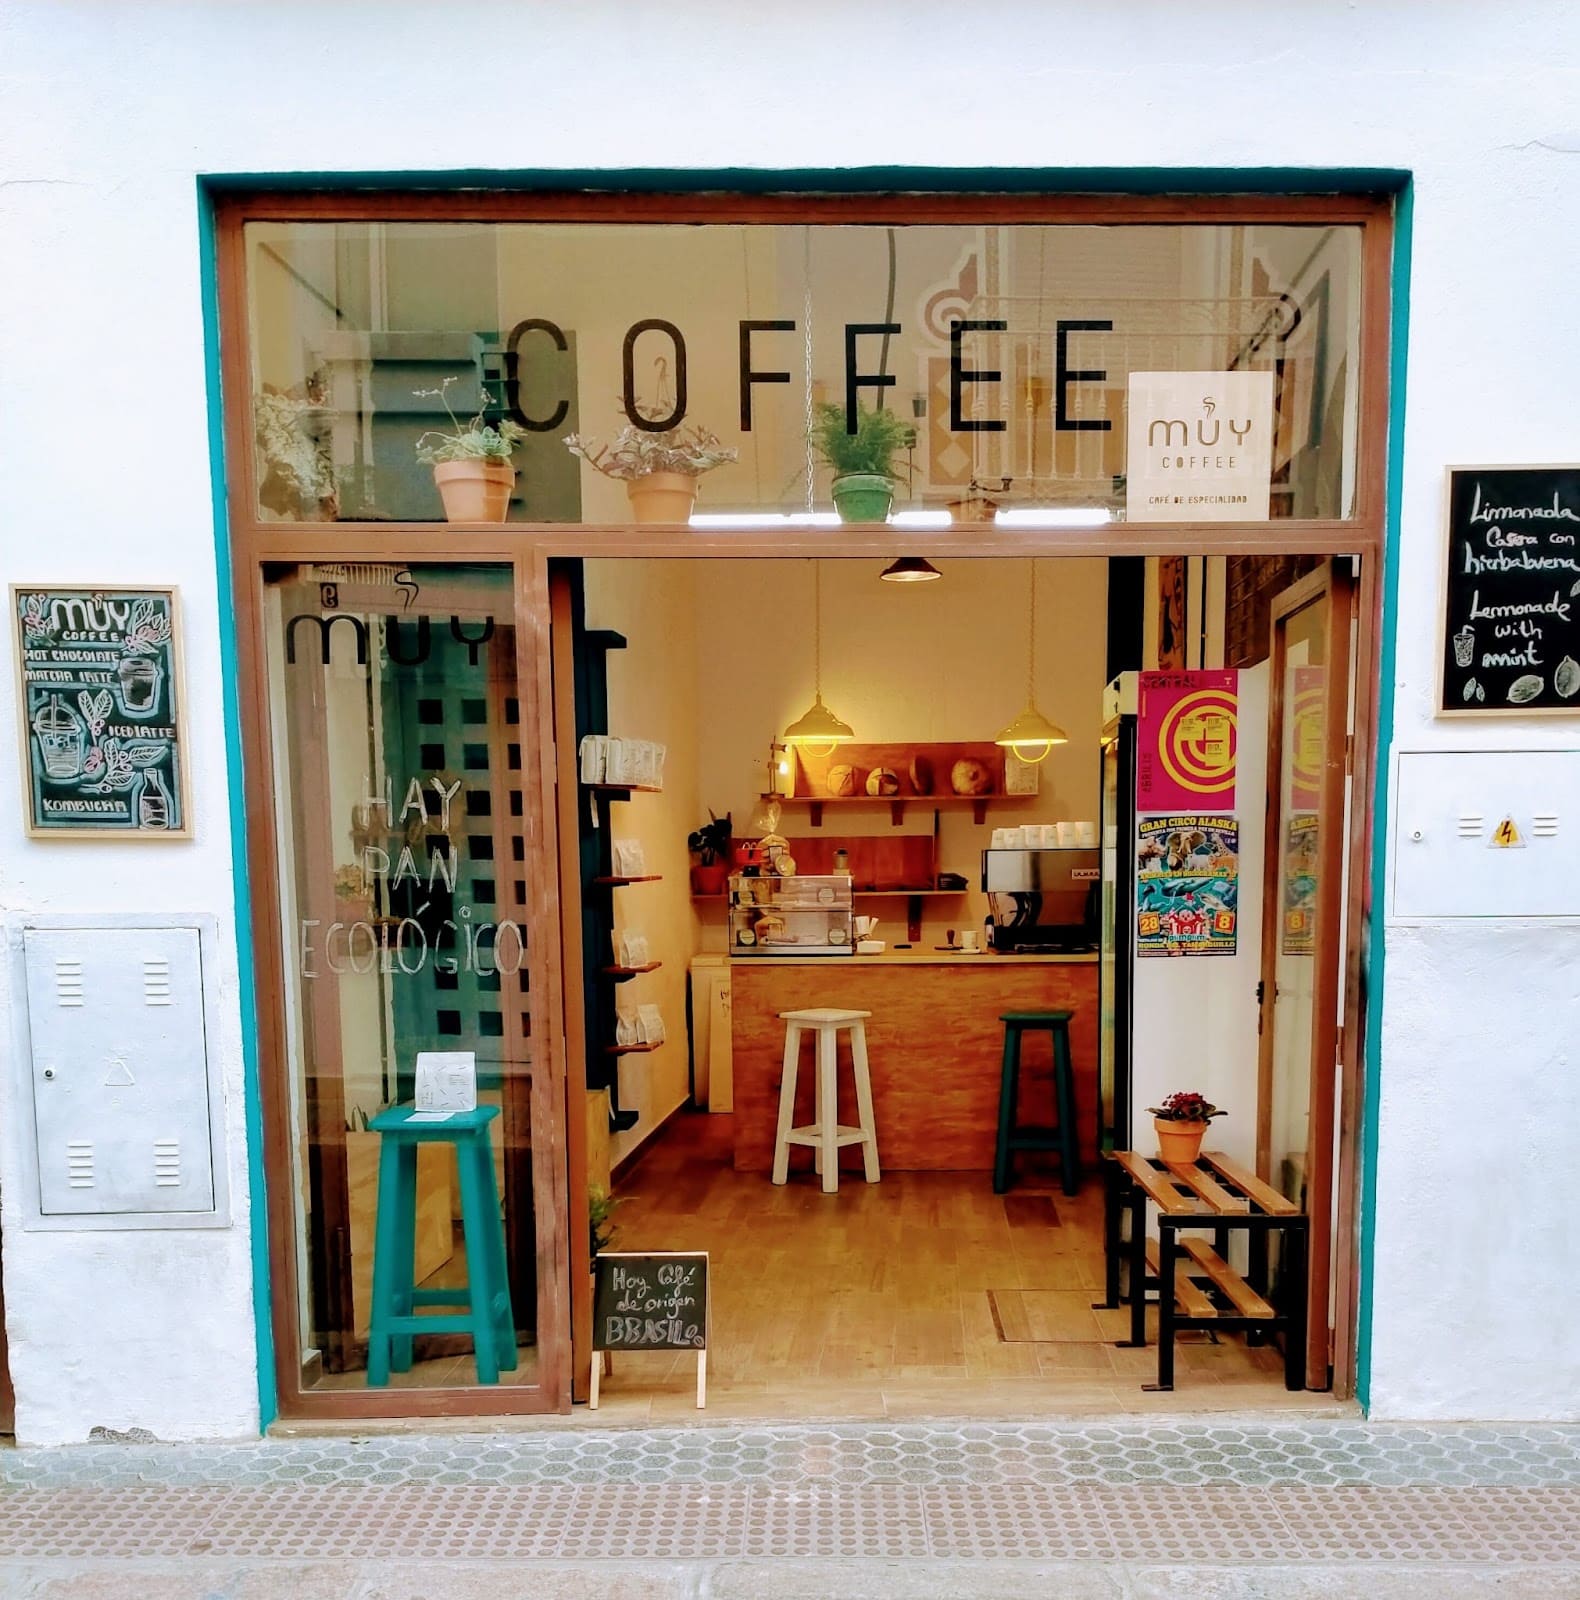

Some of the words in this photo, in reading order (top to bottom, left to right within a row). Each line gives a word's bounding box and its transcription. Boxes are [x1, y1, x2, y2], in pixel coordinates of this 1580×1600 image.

[507, 318, 1114, 435] COFFEE
[1162, 455, 1237, 469] COFFEE
[1148, 494, 1169, 504] CAFÉ
[1174, 495, 1185, 504] DE
[1188, 495, 1248, 504] ESPECIALIDAD
[1470, 481, 1580, 524] Limonada
[1549, 532, 1575, 546] con
[1470, 589, 1572, 622] Lemonade
[61, 631, 121, 642] COFFEE
[1494, 620, 1543, 639] with
[24, 649, 48, 662] HOT
[51, 650, 121, 663] CHOCOLATE
[1482, 641, 1545, 667] mint
[24, 670, 73, 683] MATCHA
[134, 725, 176, 739] LATTE
[42, 797, 128, 812] KOMBUCHA
[360, 775, 462, 831] HAY
[1140, 818, 1167, 833] GRAN
[1168, 816, 1197, 827] CIRCO
[1197, 816, 1238, 832] ALASKA
[360, 845, 459, 895] PAN
[1141, 916, 1158, 930] 28
[1219, 914, 1230, 929] 8
[612, 1266, 652, 1298] Hoy
[657, 1263, 696, 1297] Café
[615, 1289, 642, 1311] de
[643, 1292, 696, 1319] origen
[605, 1315, 691, 1345] BRASIL
